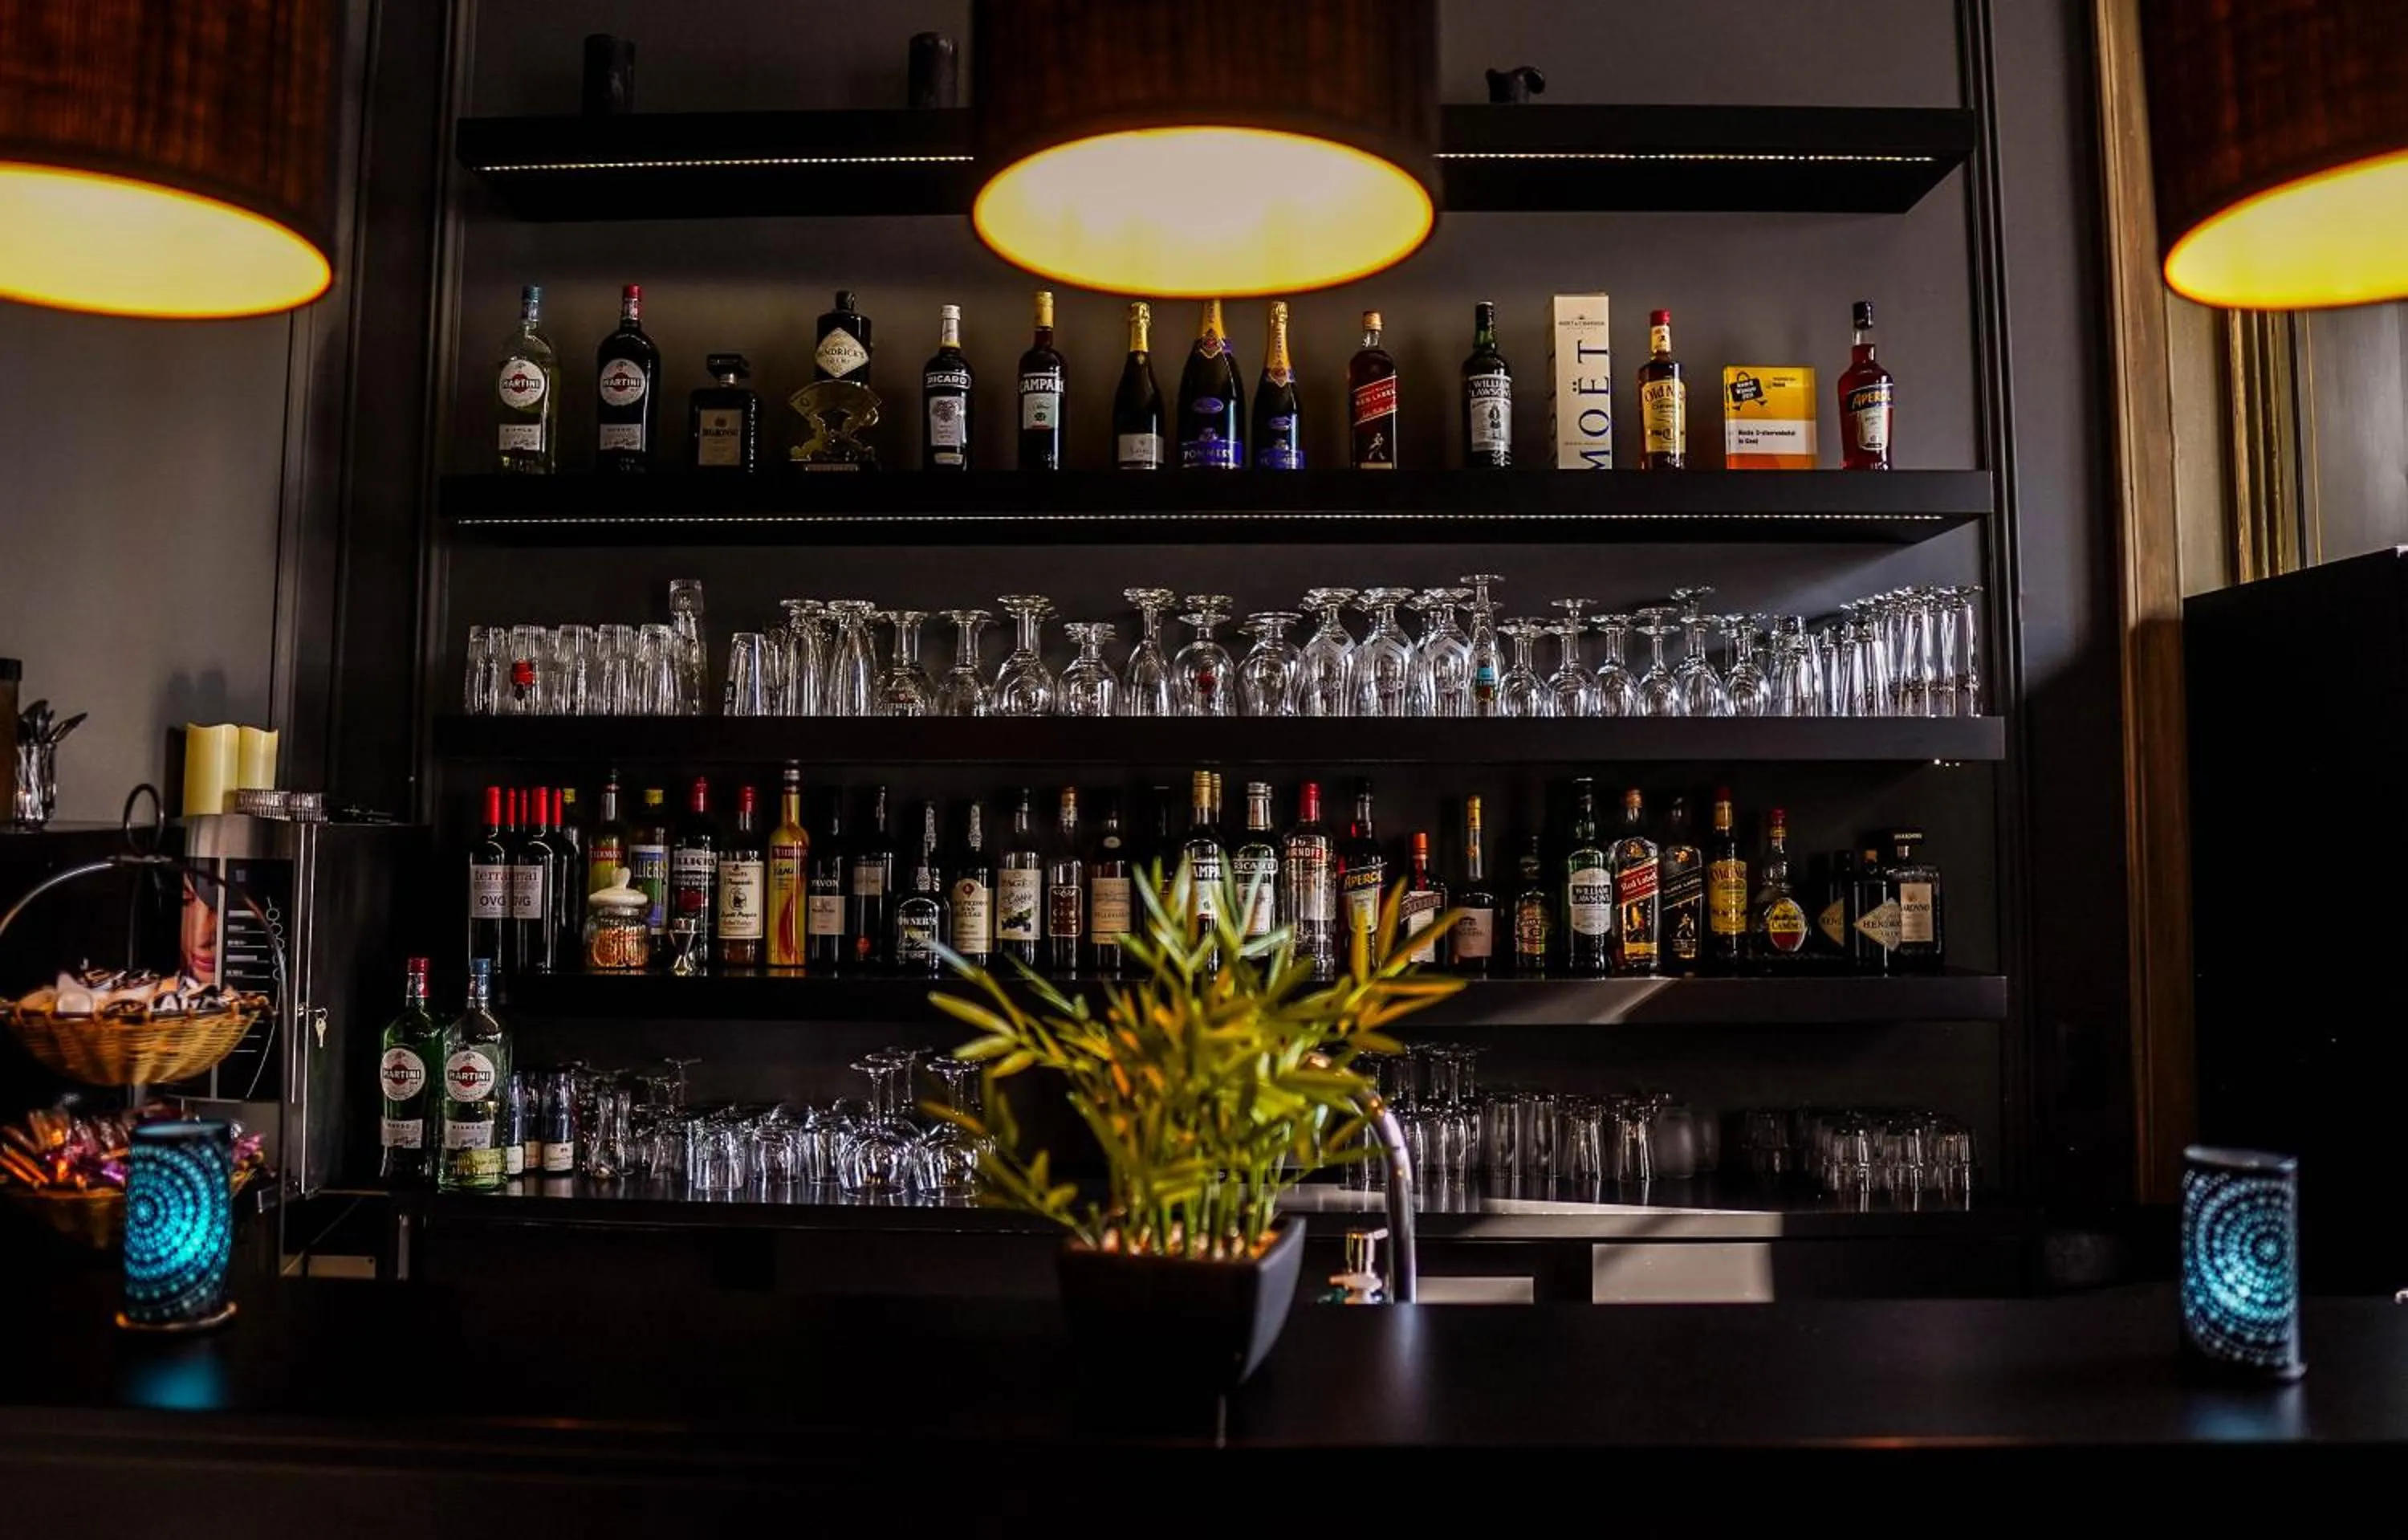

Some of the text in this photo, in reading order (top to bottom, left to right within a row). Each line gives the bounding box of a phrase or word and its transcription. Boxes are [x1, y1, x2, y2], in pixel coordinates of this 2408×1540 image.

[502, 378, 541, 389] MARTINI
[604, 377, 641, 389] MARTINI
[1572, 339, 1610, 470] MOËT
[1233, 860, 1275, 870] RICAD
[383, 1069, 421, 1081] MARTINI
[449, 1070, 490, 1082] MARTINI
